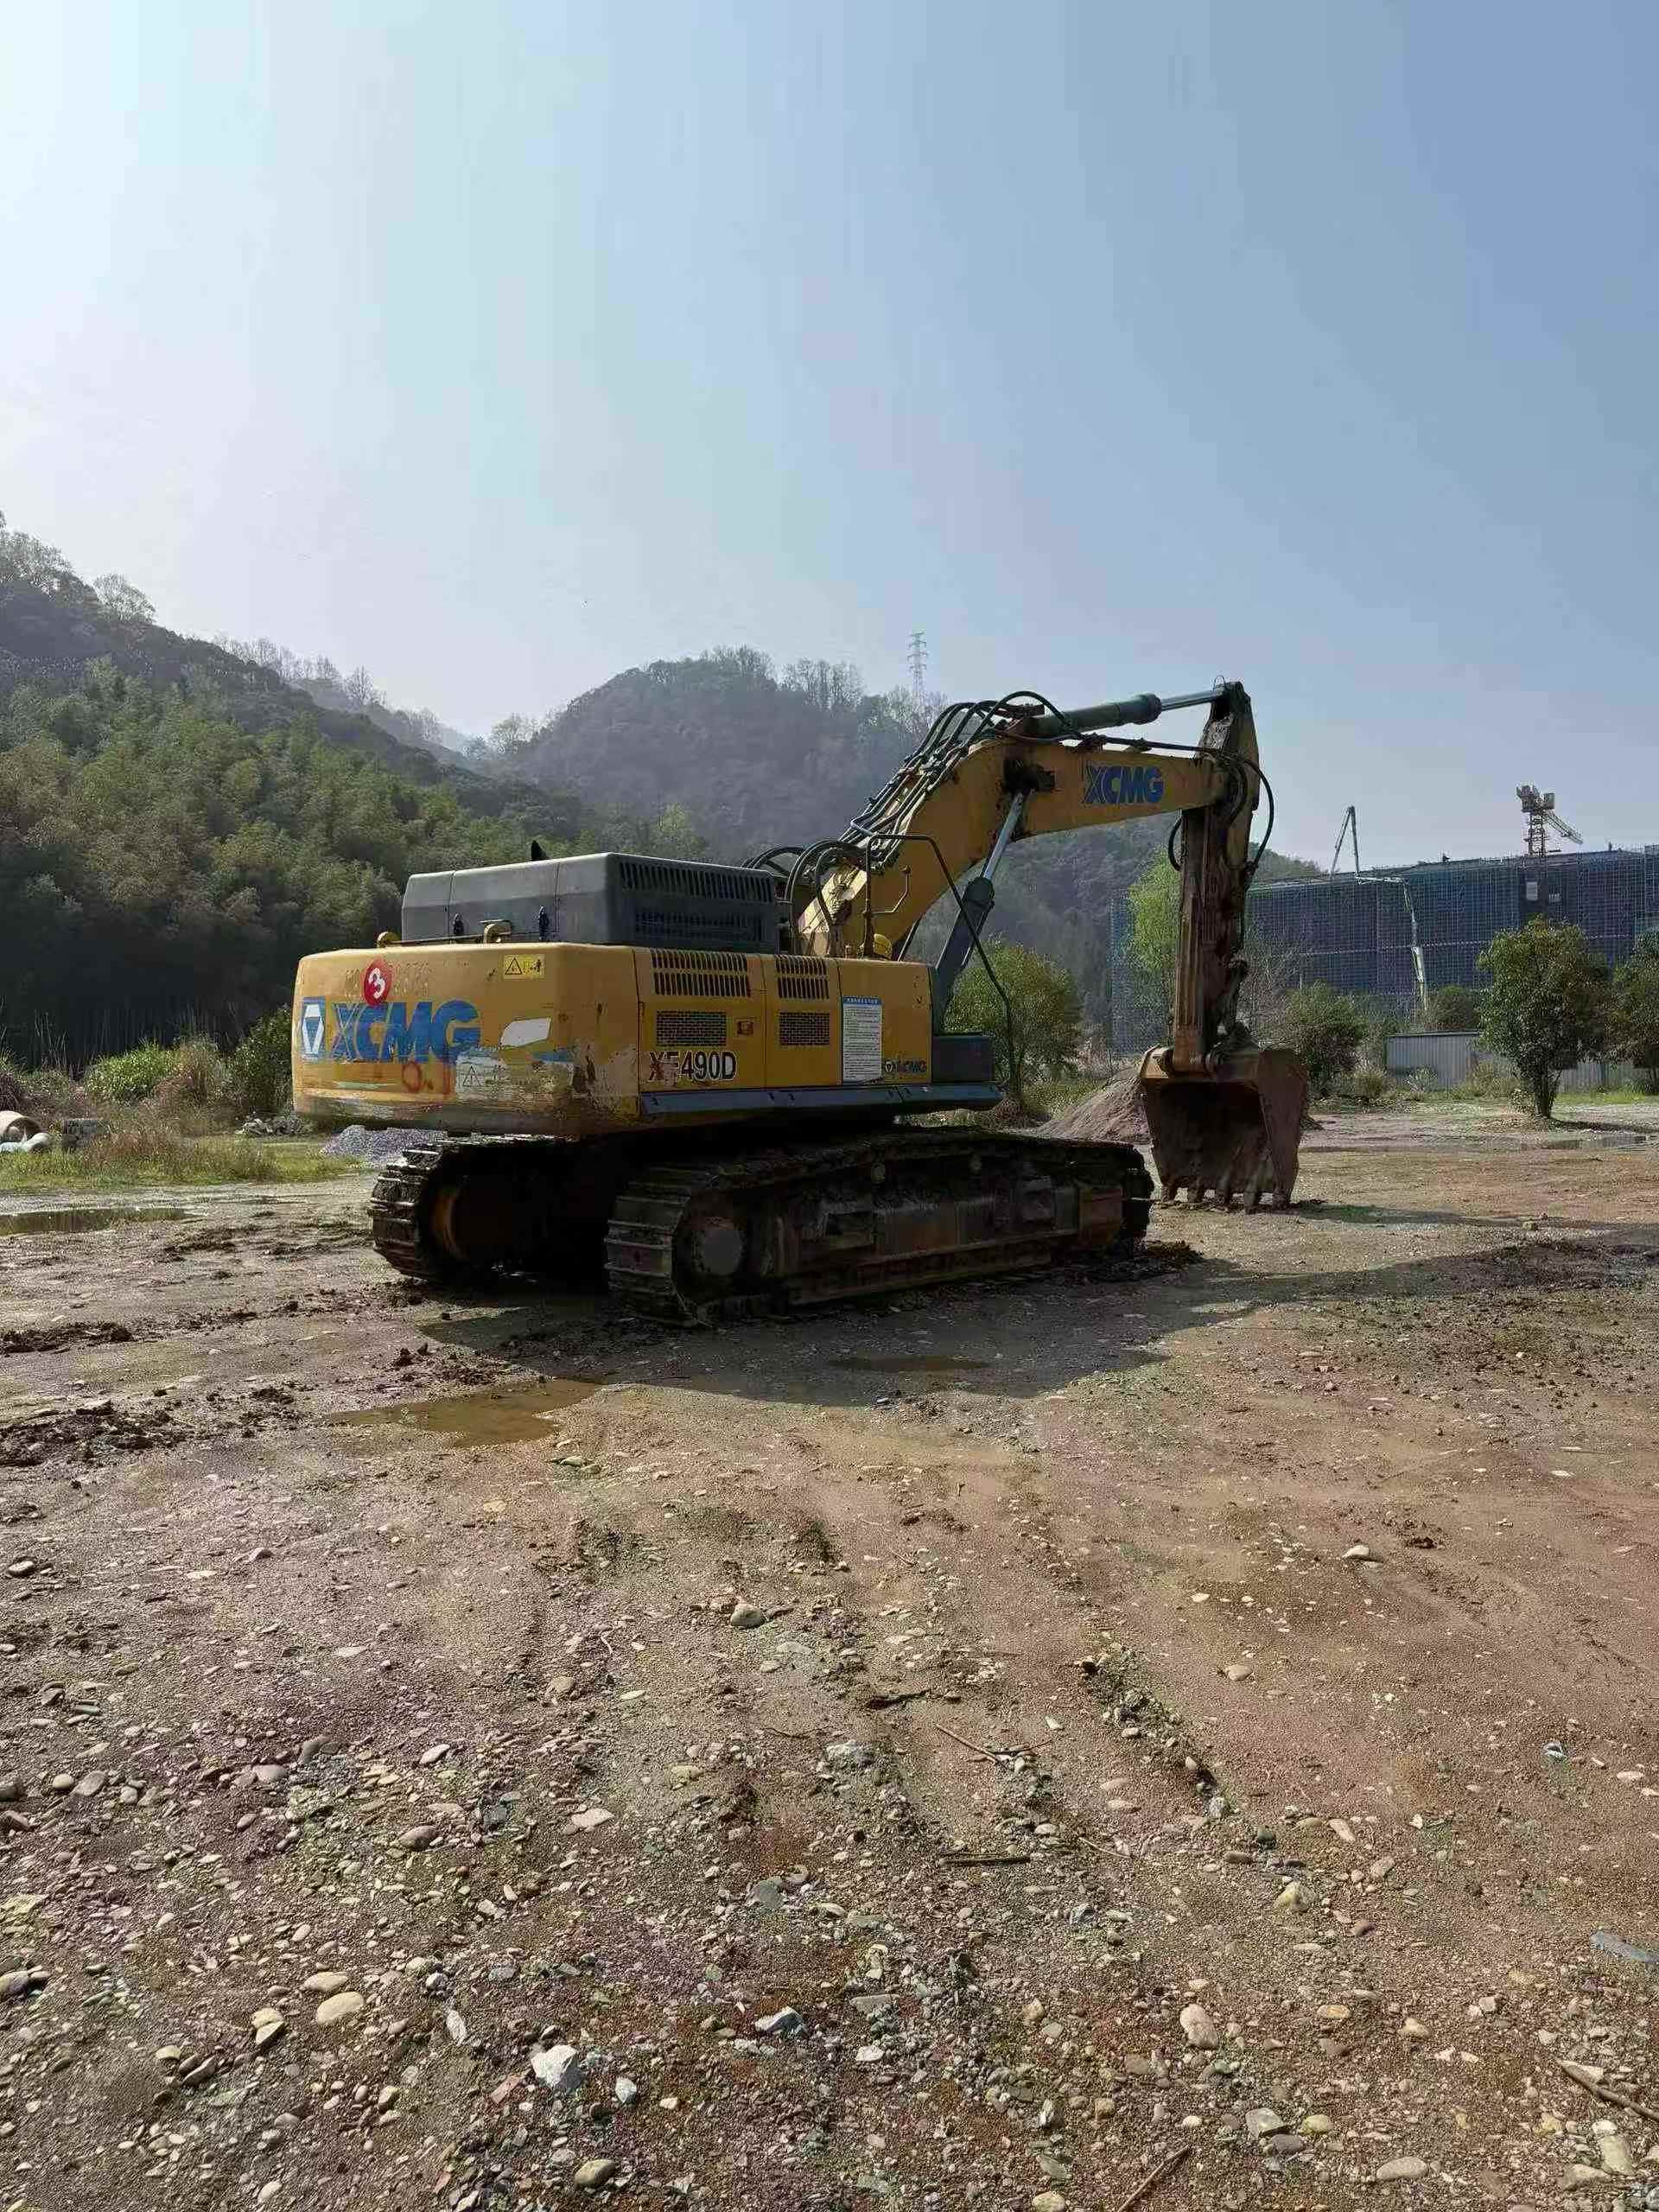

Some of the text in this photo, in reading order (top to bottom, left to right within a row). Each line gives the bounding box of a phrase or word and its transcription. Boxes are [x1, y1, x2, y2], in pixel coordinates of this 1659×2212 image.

[1083, 766, 1164, 804] XCMG
[369, 968, 386, 1000] 3
[332, 999, 480, 1064] XCMG
